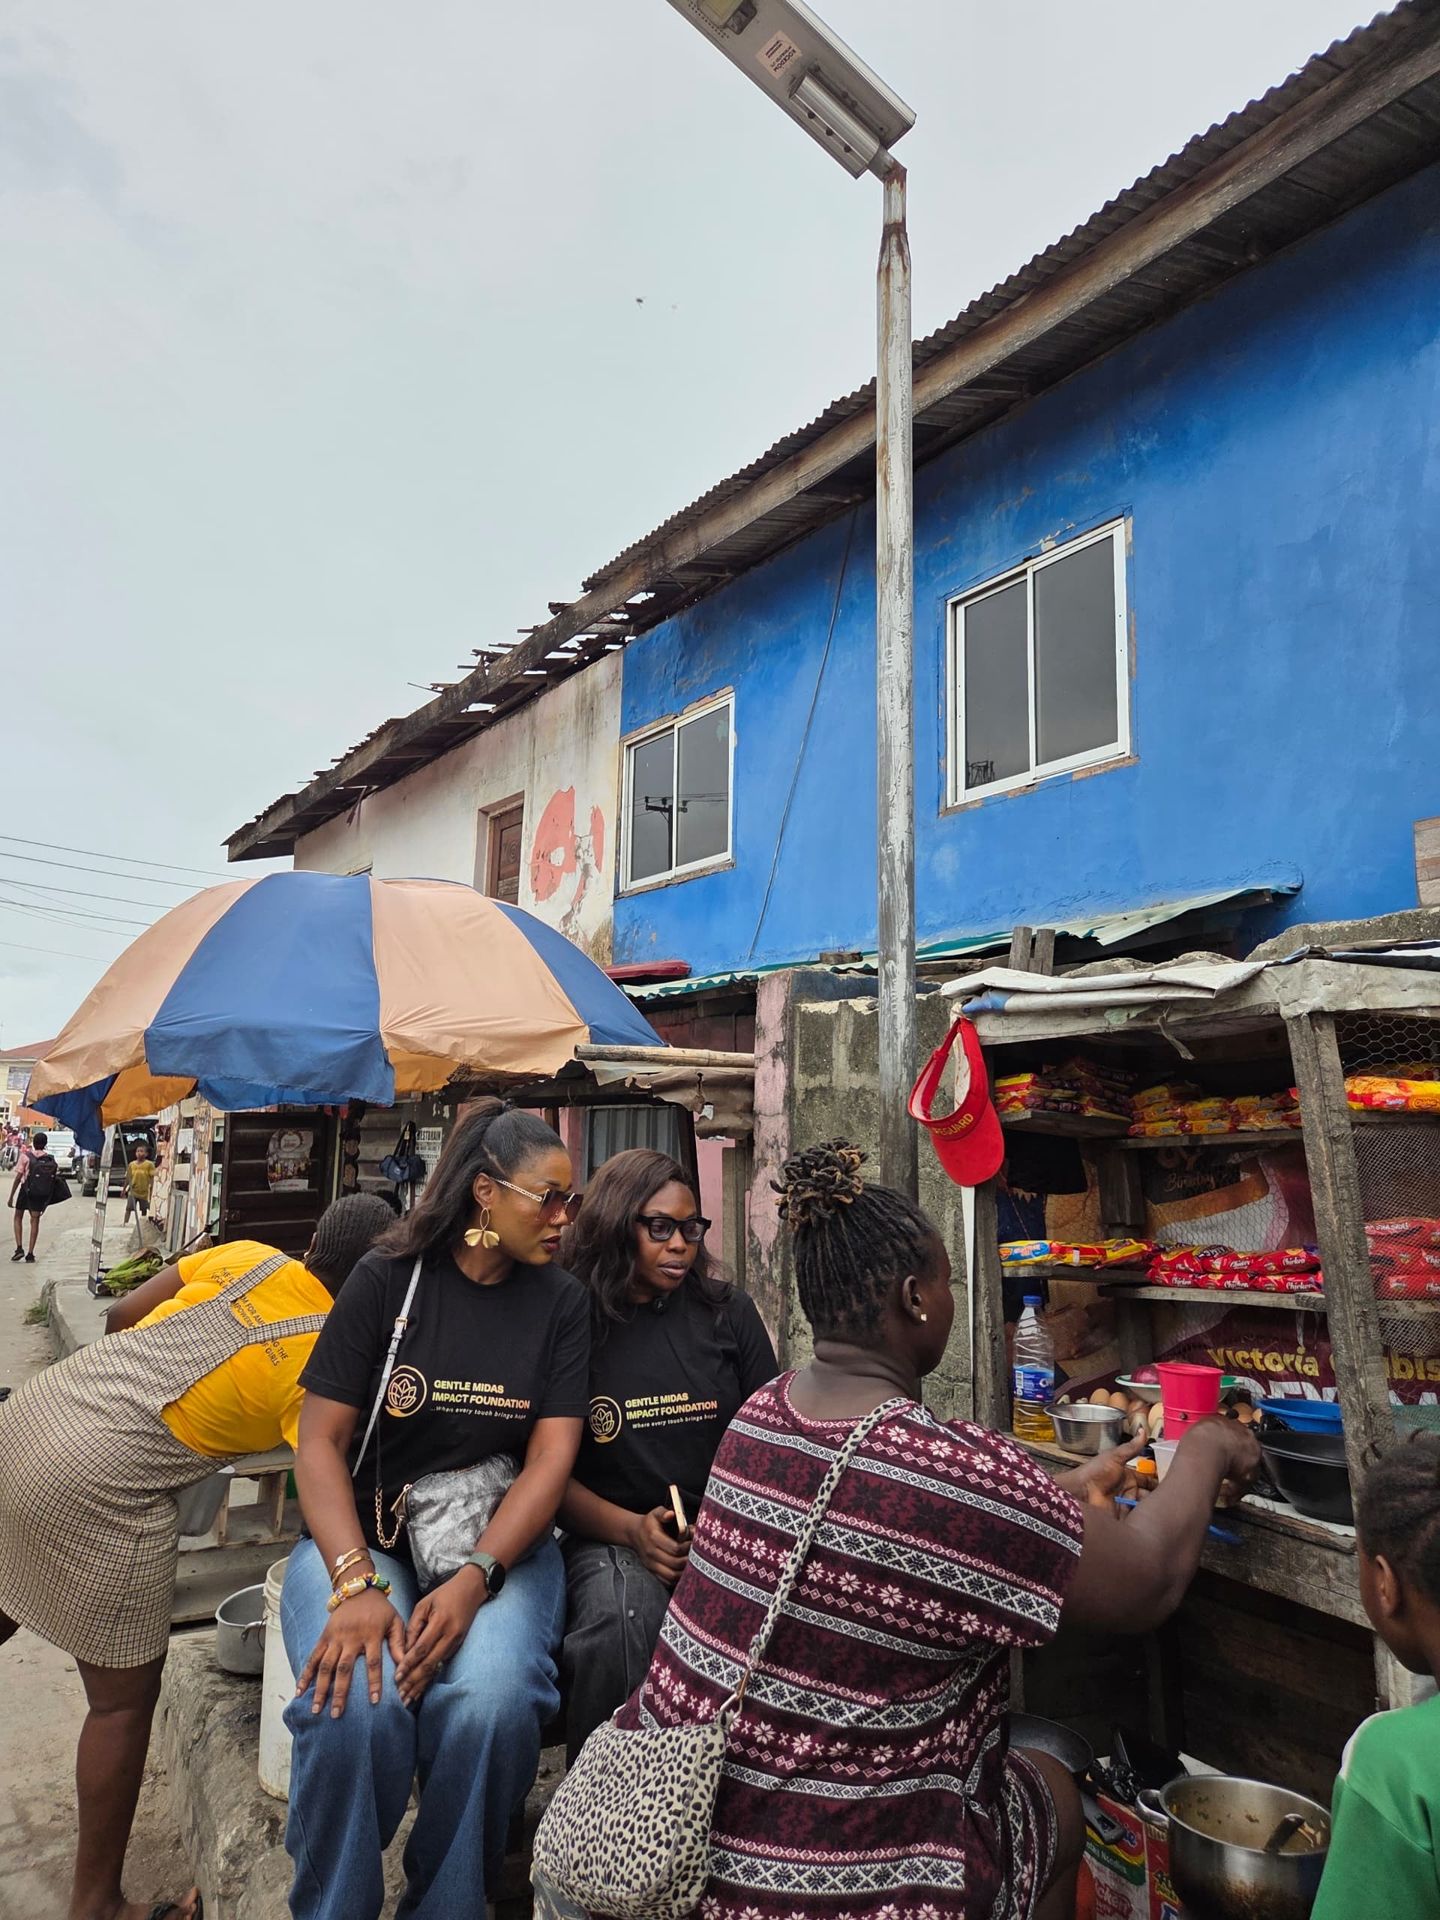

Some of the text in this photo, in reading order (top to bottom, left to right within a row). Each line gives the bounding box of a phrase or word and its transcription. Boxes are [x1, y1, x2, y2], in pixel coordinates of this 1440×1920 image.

[1207, 1346, 1320, 1377] Victoria
[433, 1380, 504, 1394] GENTLE MIDAS
[432, 1392, 530, 1409] IMPACT FOUNDATION
[625, 1392, 689, 1408] GENTLE MIDAS
[626, 1400, 718, 1420] IMPACT FOUNDATION
